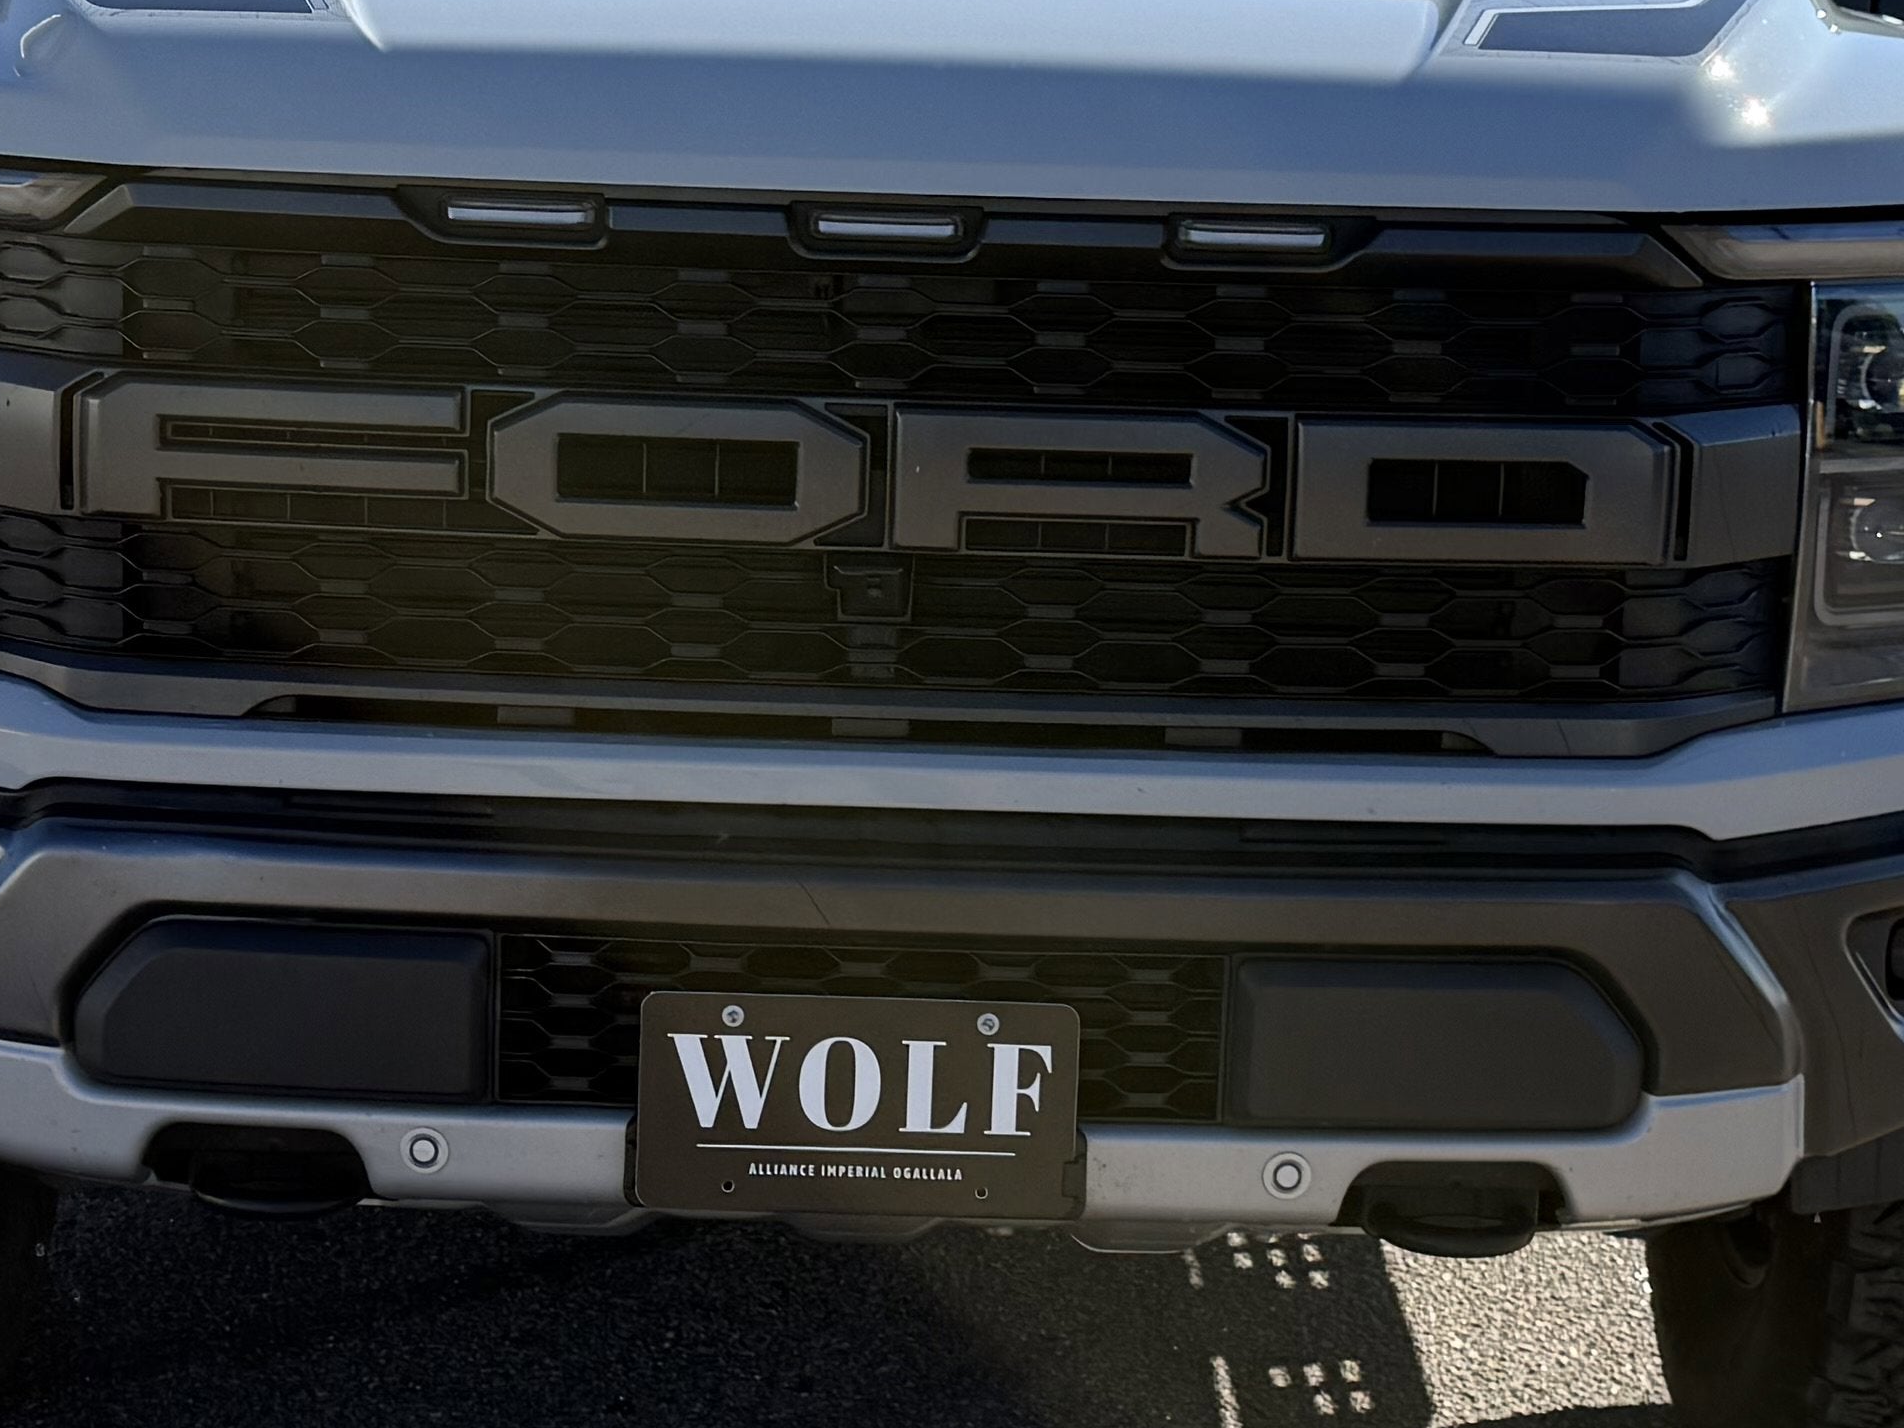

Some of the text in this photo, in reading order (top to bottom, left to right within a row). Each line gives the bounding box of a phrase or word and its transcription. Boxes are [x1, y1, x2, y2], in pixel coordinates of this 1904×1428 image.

[76, 369, 1676, 564] FORD
[666, 1032, 1053, 1137] WOLF
[748, 1162, 963, 1181] ALLIANCE IMPERIAL OGALLALA
